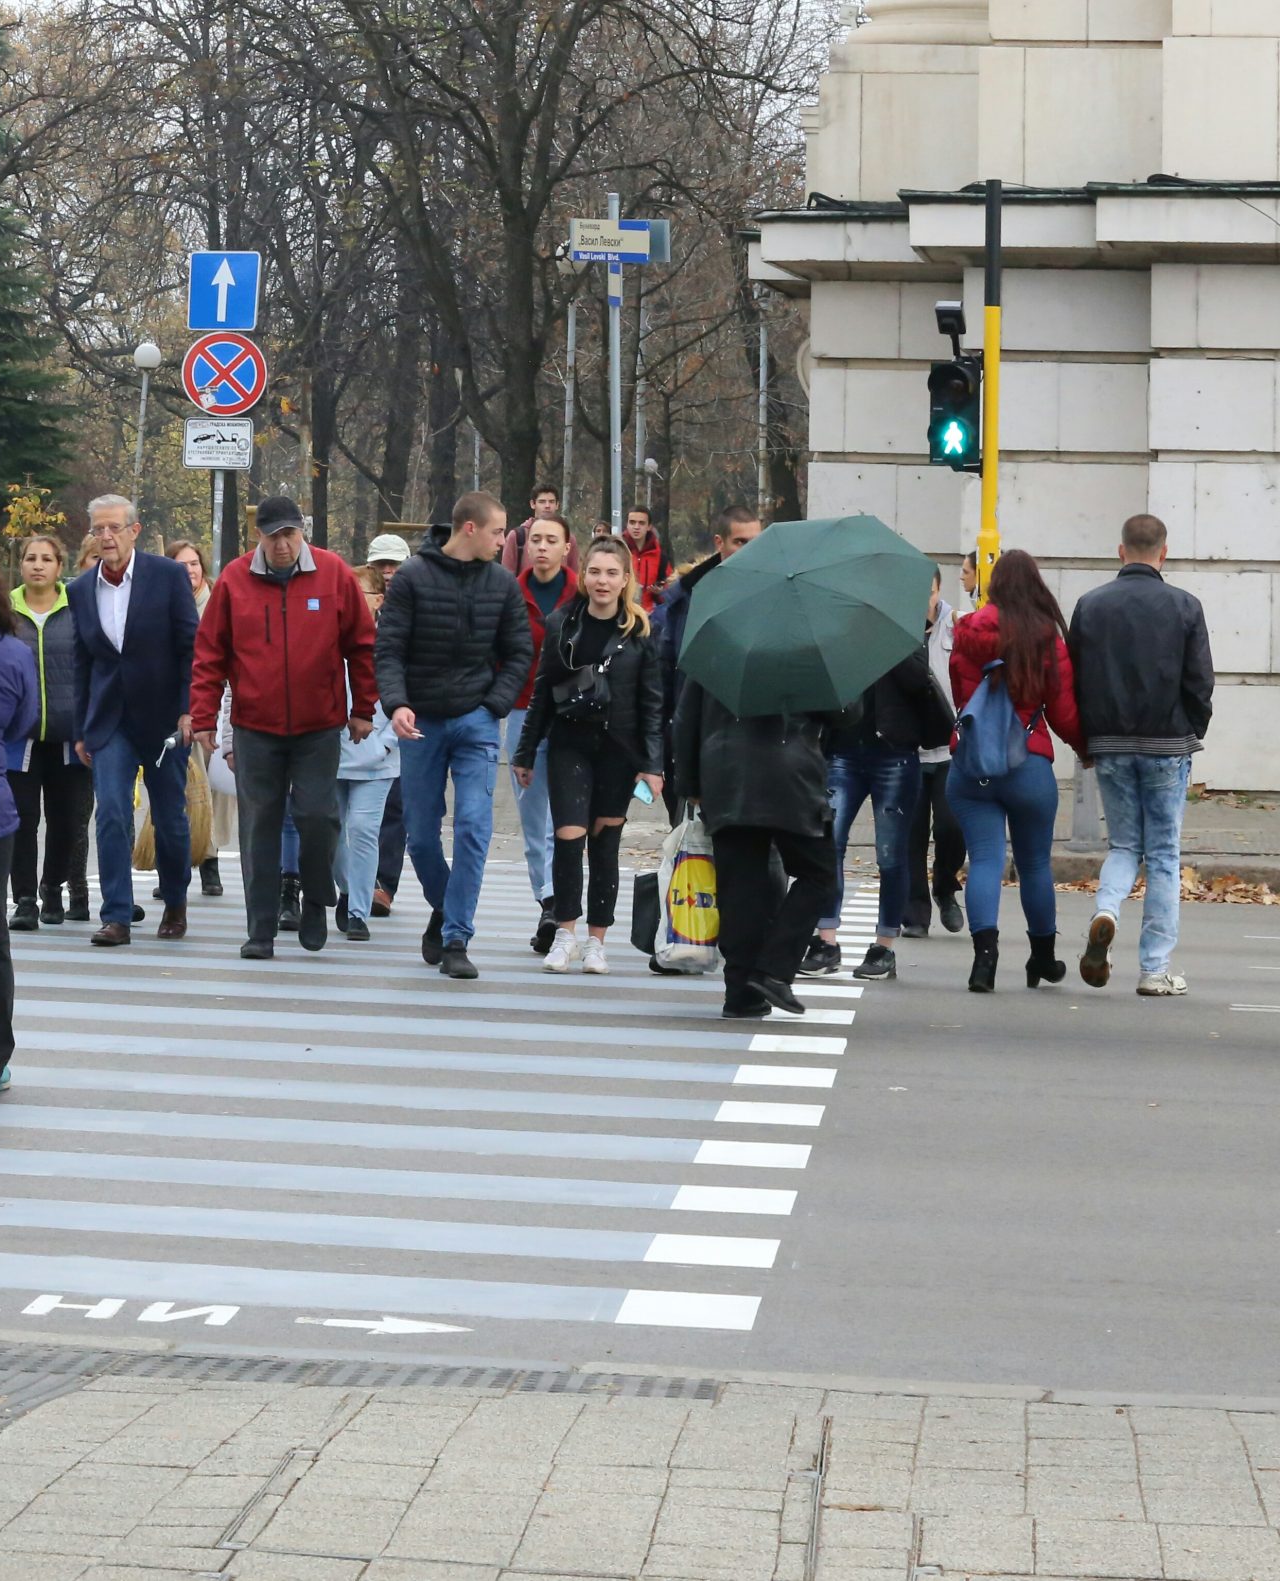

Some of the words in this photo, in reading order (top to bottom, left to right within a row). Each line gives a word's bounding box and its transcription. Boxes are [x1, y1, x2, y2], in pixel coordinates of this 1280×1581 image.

[578, 251, 590, 260] Vasil
[591, 252, 606, 261] Levski
[607, 252, 620, 261] Blvd.
